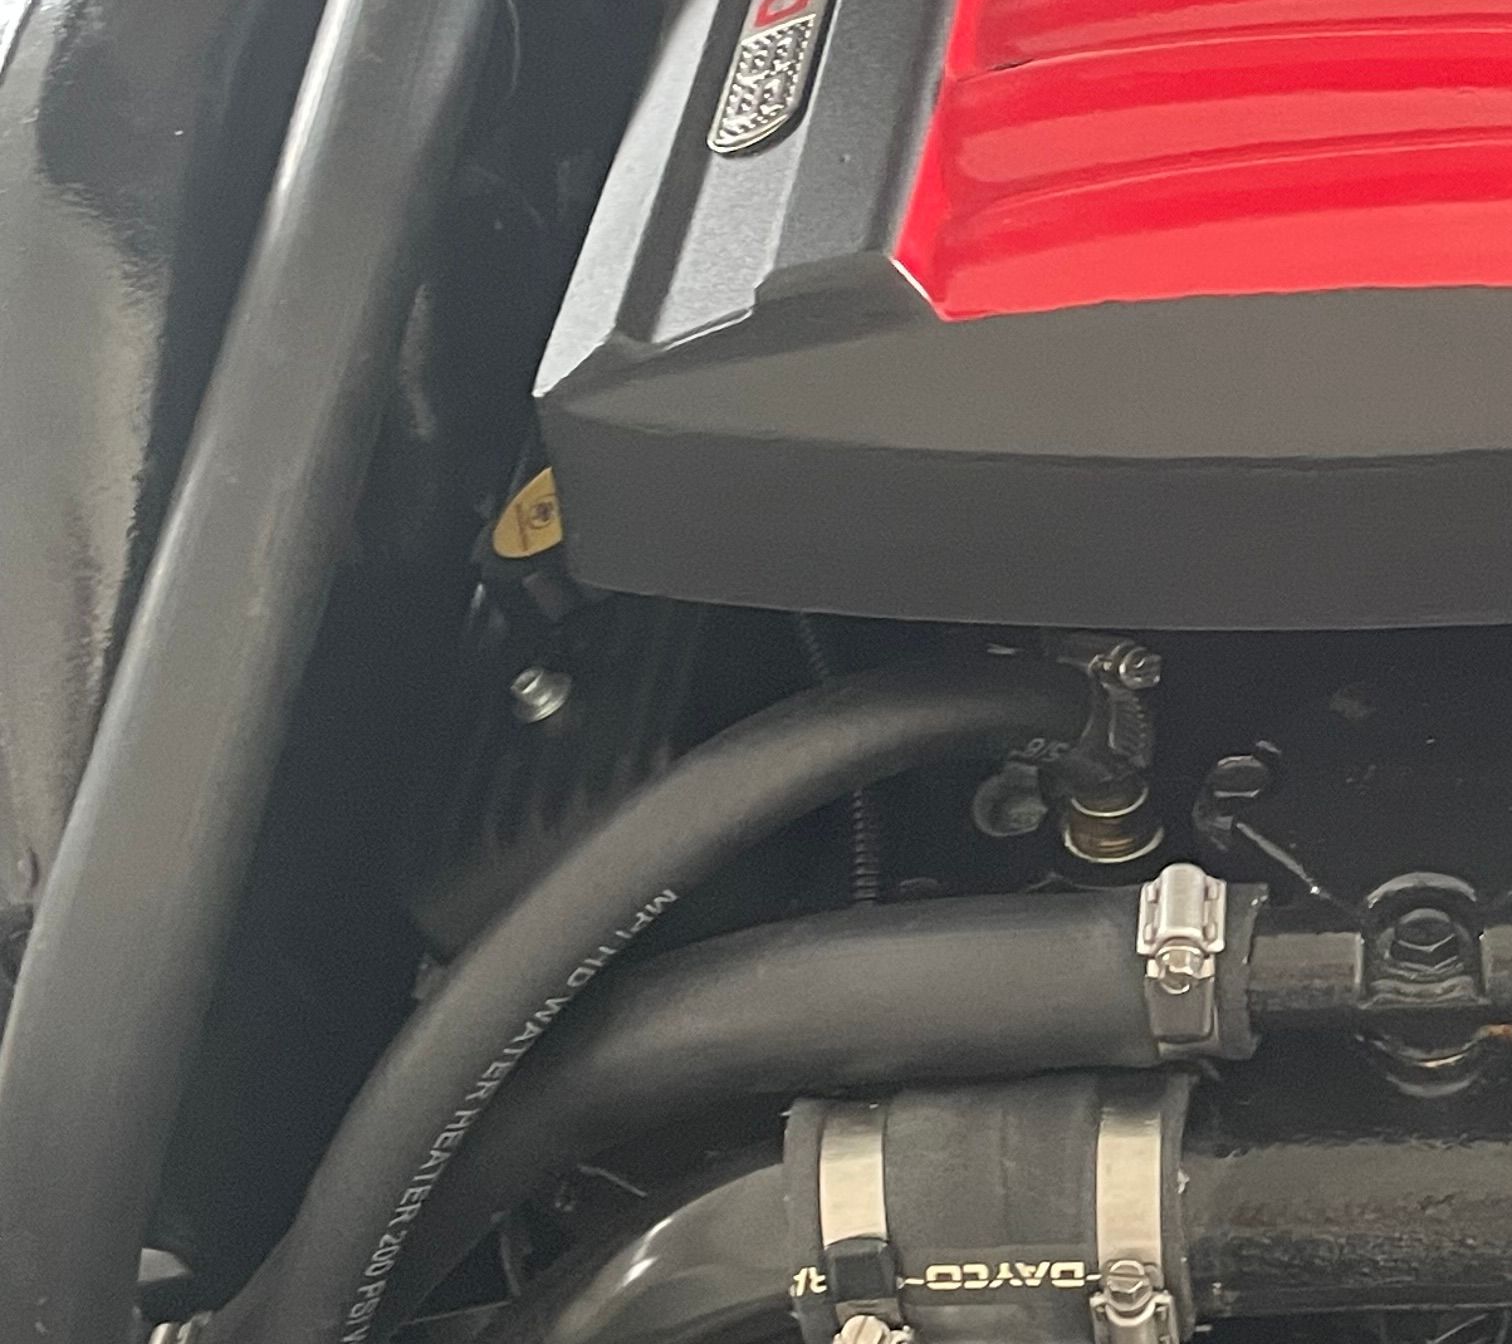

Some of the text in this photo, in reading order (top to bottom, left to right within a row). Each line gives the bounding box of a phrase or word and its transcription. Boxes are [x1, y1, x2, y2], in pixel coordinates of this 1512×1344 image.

[615, 889, 680, 939] MPI
[566, 946, 618, 987] HD
[465, 997, 571, 1101] WATER
[389, 1108, 481, 1227] HEATER
[364, 1230, 408, 1277] 200
[925, 1261, 1086, 1290] DAYCO
[346, 1280, 387, 1326] PSI
